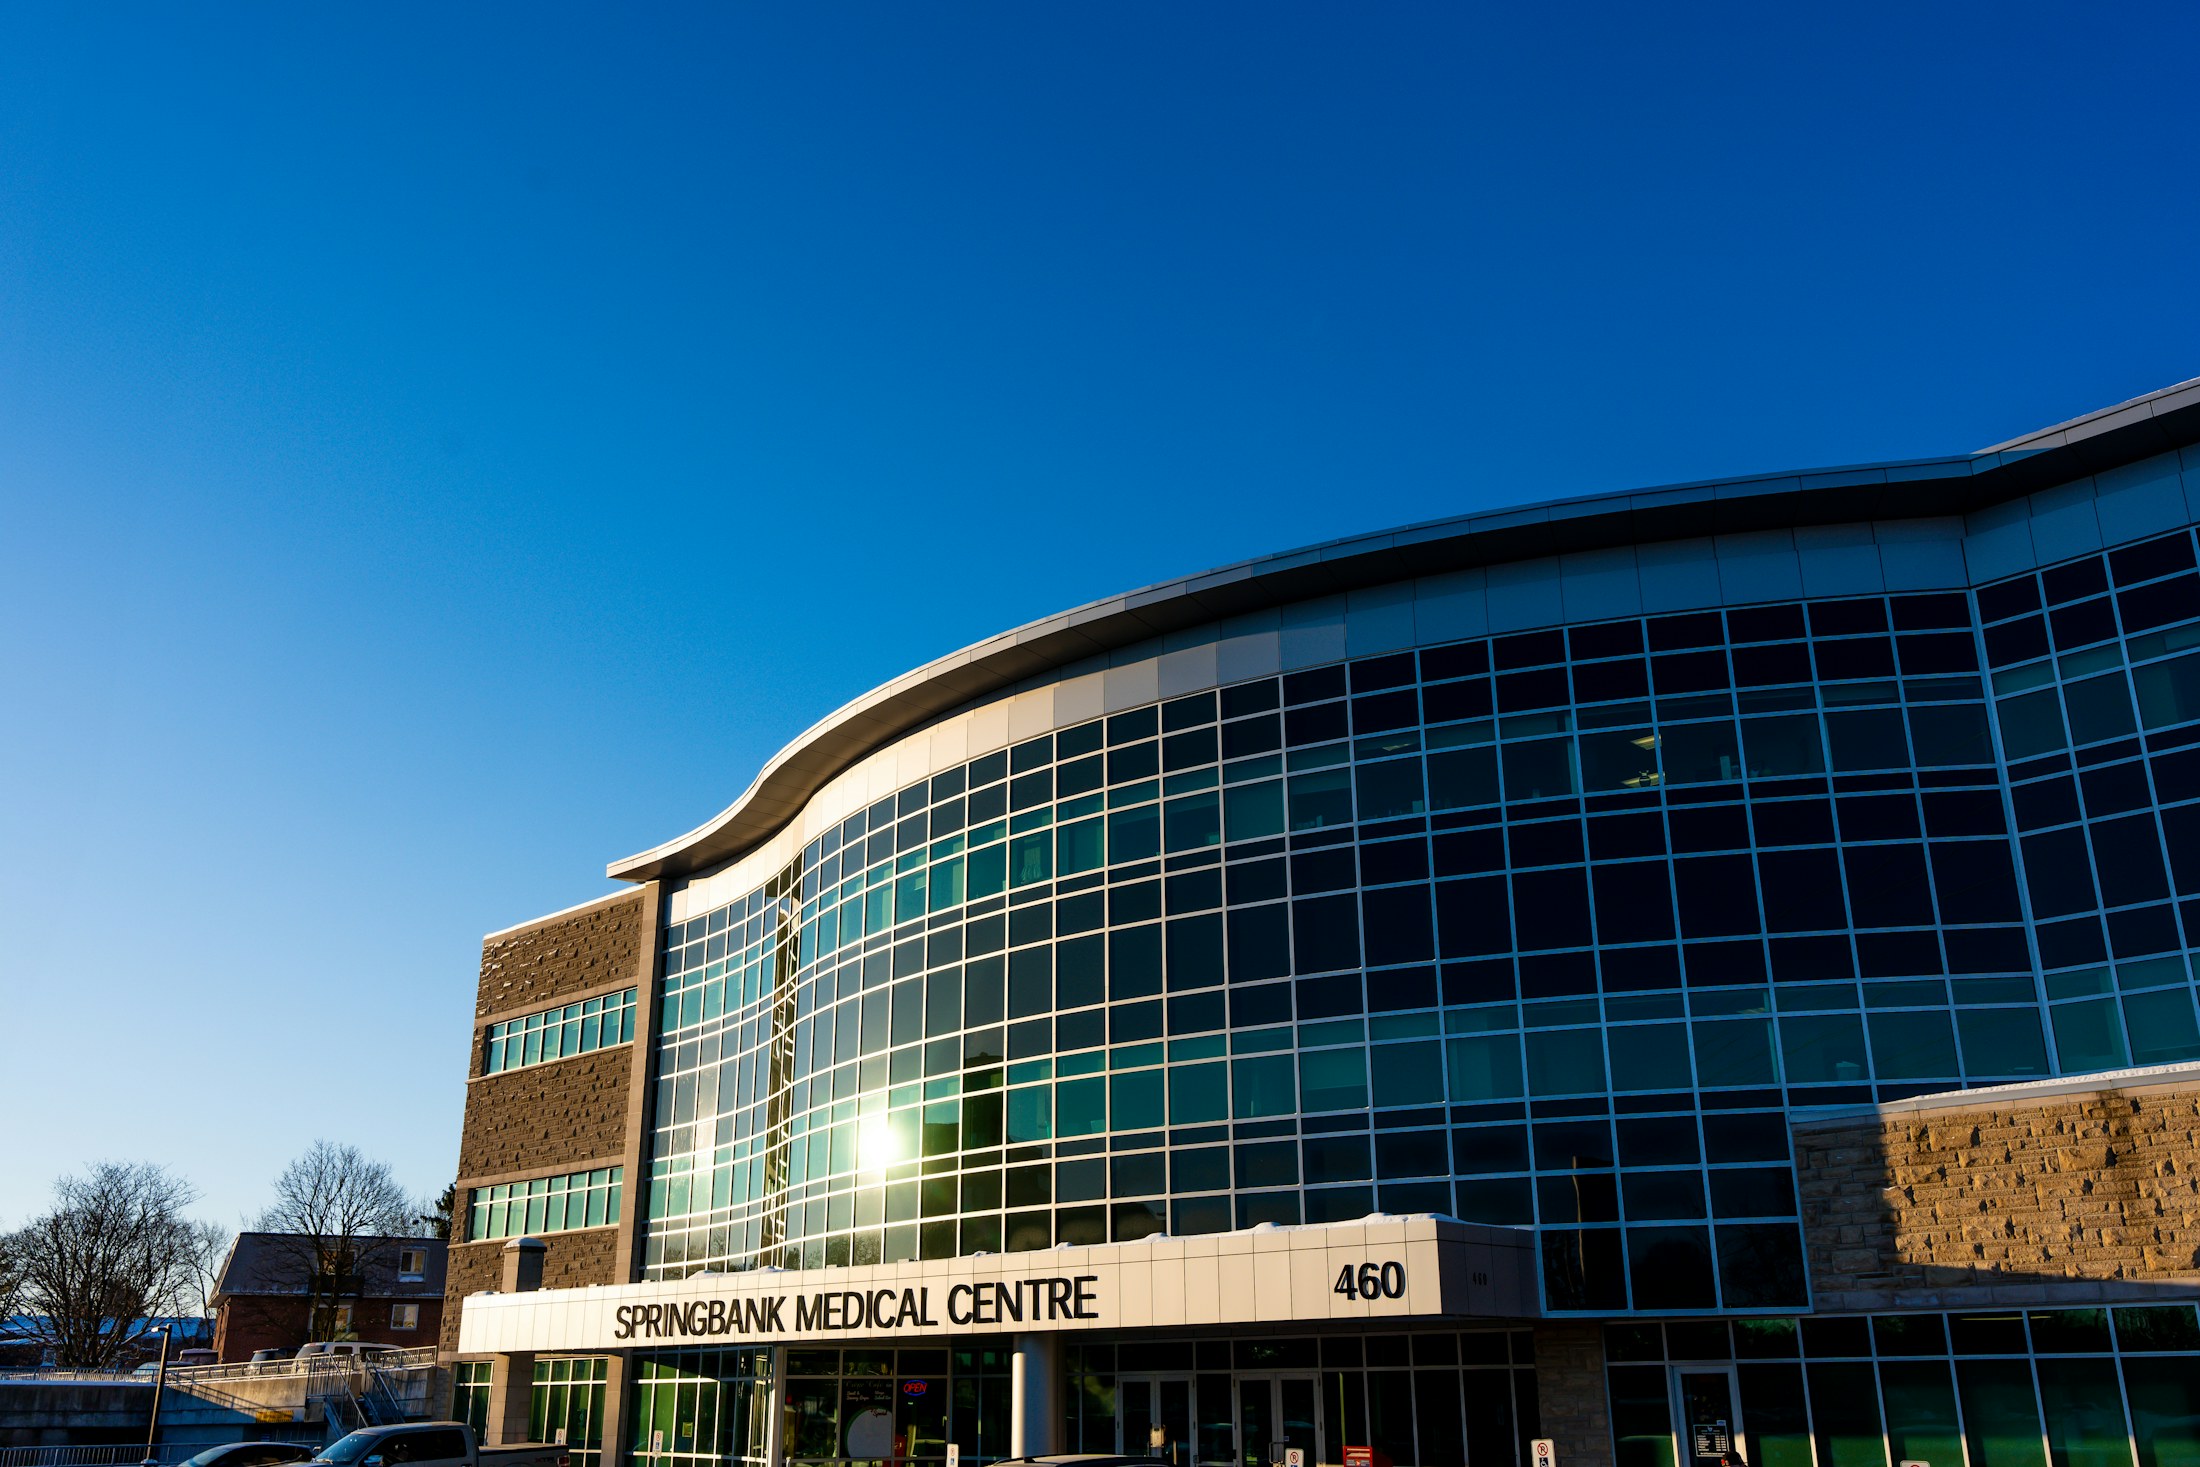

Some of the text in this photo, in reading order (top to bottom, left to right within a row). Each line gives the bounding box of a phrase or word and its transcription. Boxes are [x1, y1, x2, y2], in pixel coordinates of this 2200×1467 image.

[1334, 1261, 1406, 1301] 460
[1472, 1272, 1487, 1285] 460
[614, 1275, 1099, 1339] SPRINGBANK MEDICAL CENTRE
[903, 1383, 927, 1393] OPEN
